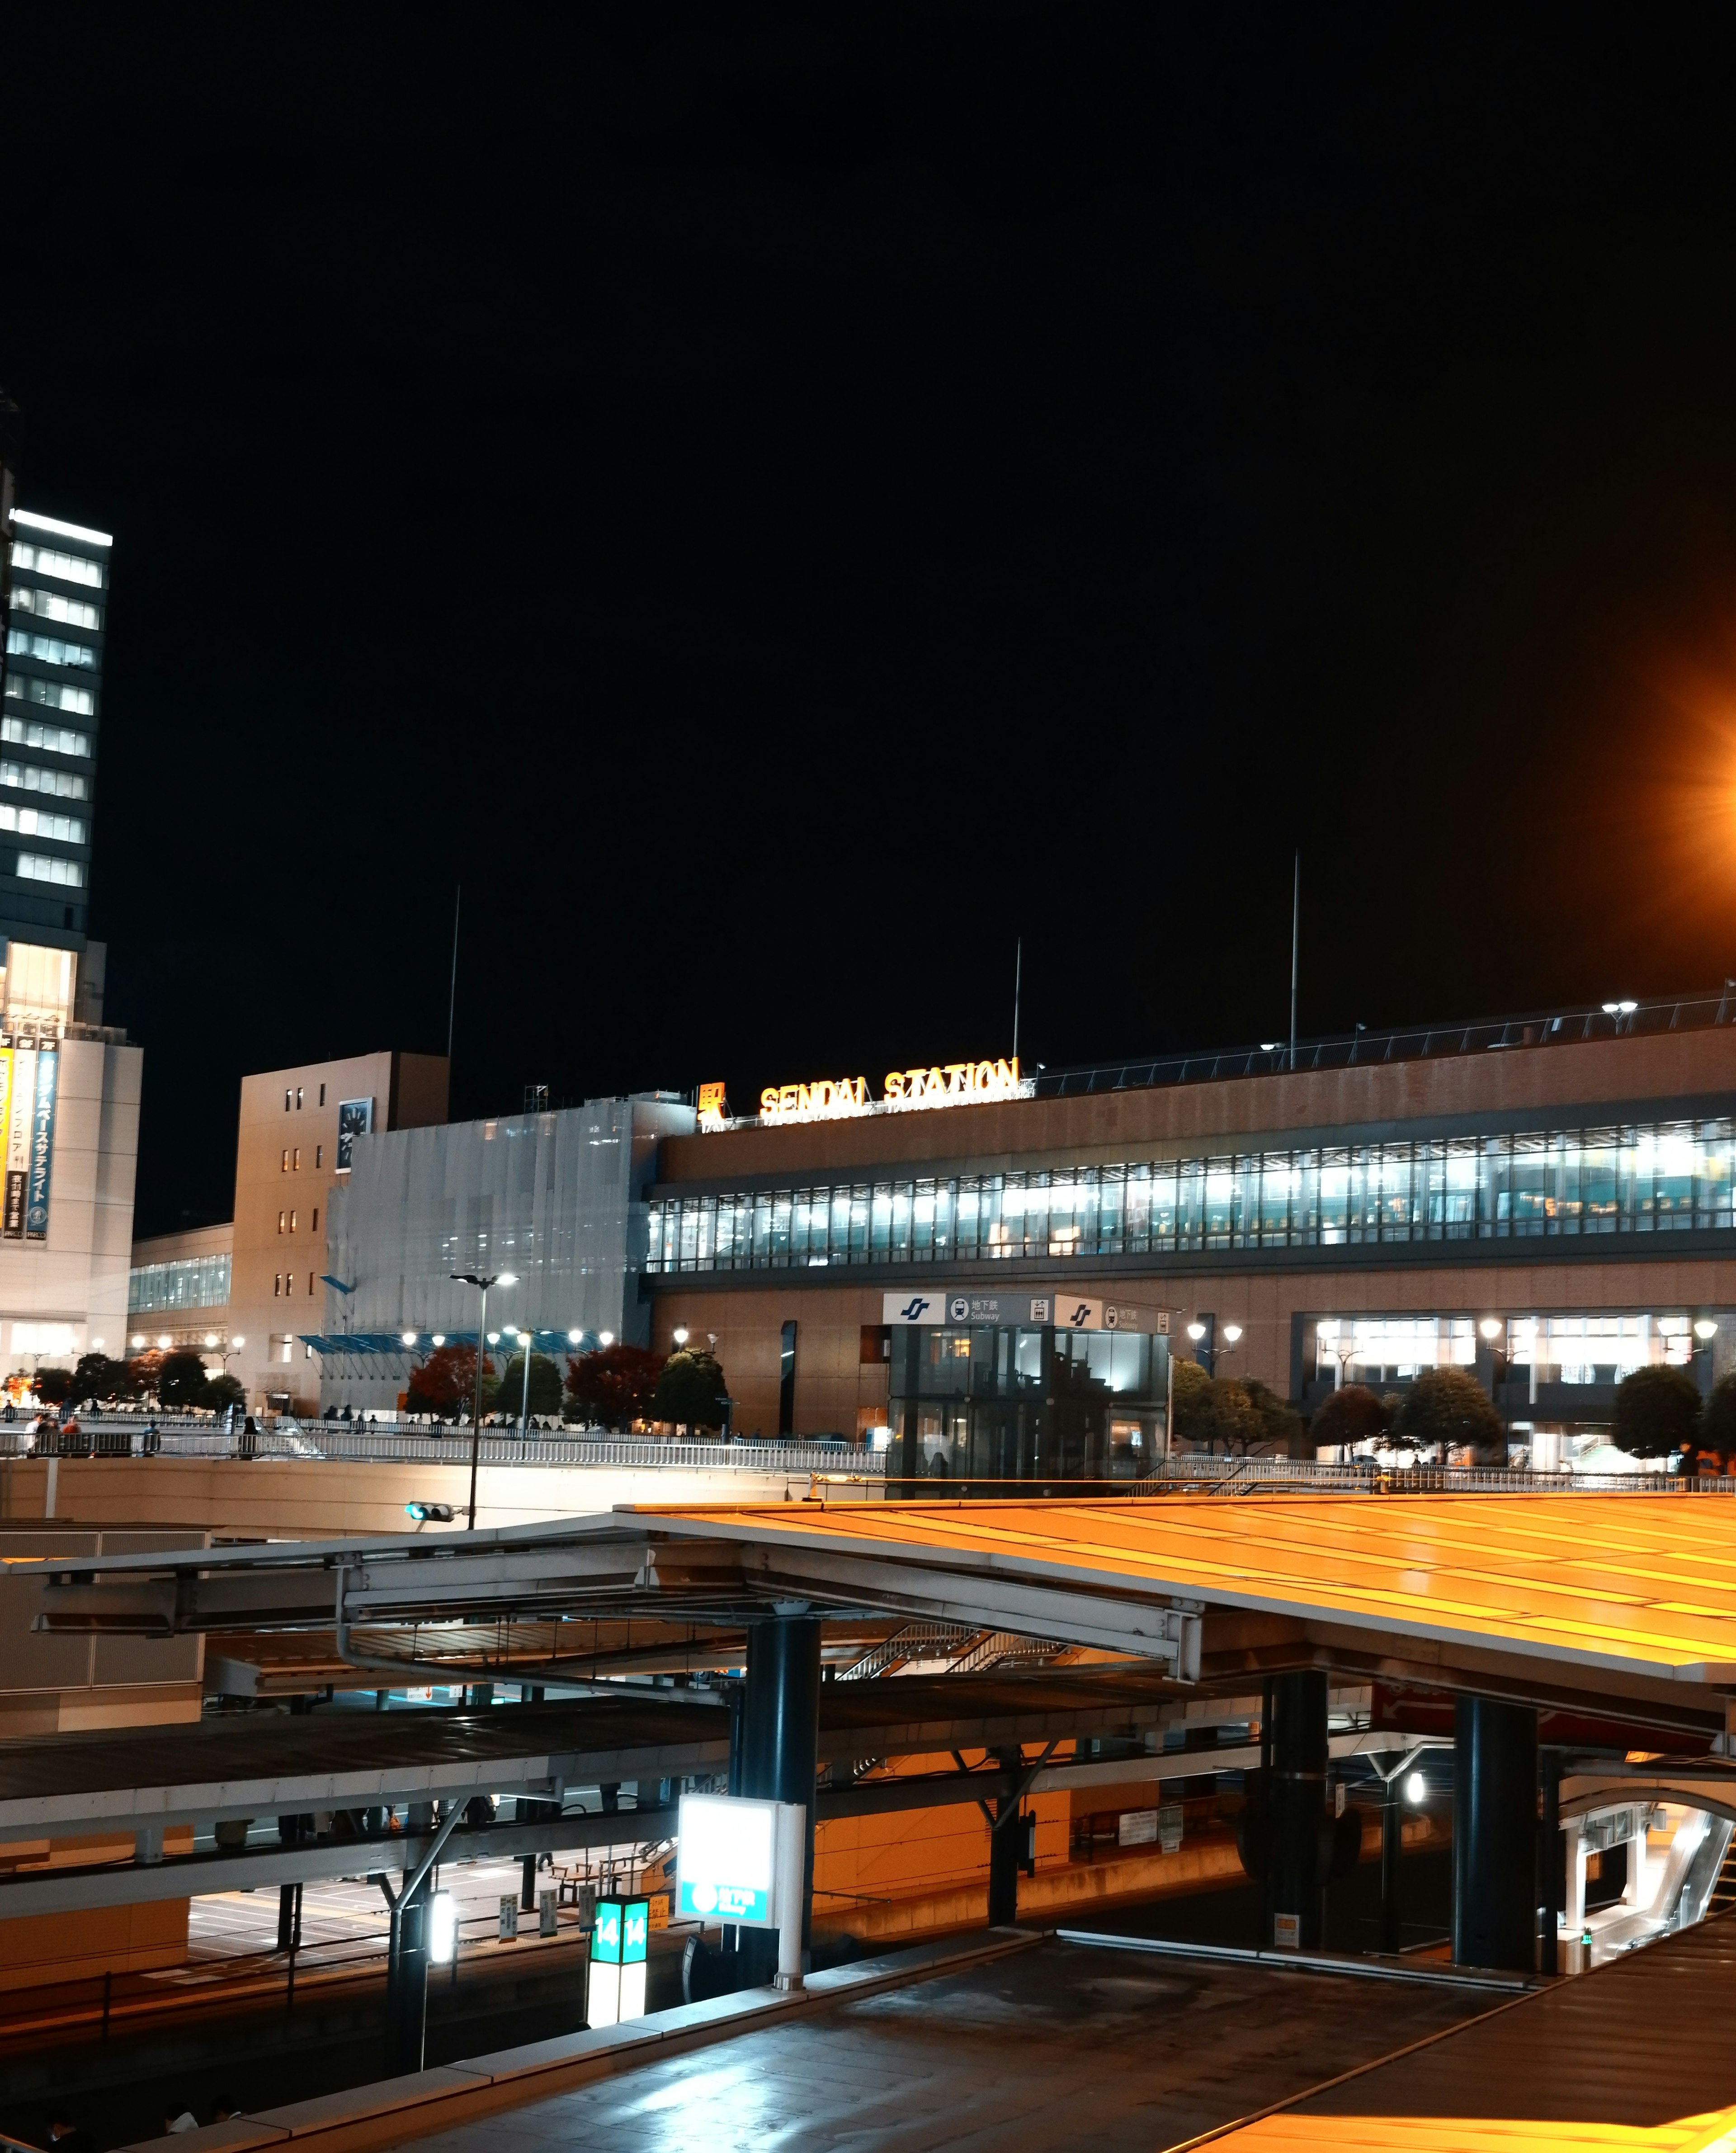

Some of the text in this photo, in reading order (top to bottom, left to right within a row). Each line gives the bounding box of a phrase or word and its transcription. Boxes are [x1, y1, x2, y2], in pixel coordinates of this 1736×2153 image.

[760, 1057, 1019, 1119] SENDAI STATION
[13, 1055, 26, 1152] ランフロア
[971, 1299, 999, 1311] 地下鉄
[1119, 1309, 1137, 1320] 地下鉄
[971, 1312, 1000, 1322] Subway
[1118, 1320, 1139, 1331] Subway
[594, 1916, 619, 1947] 14
[625, 1916, 646, 1946] 14
